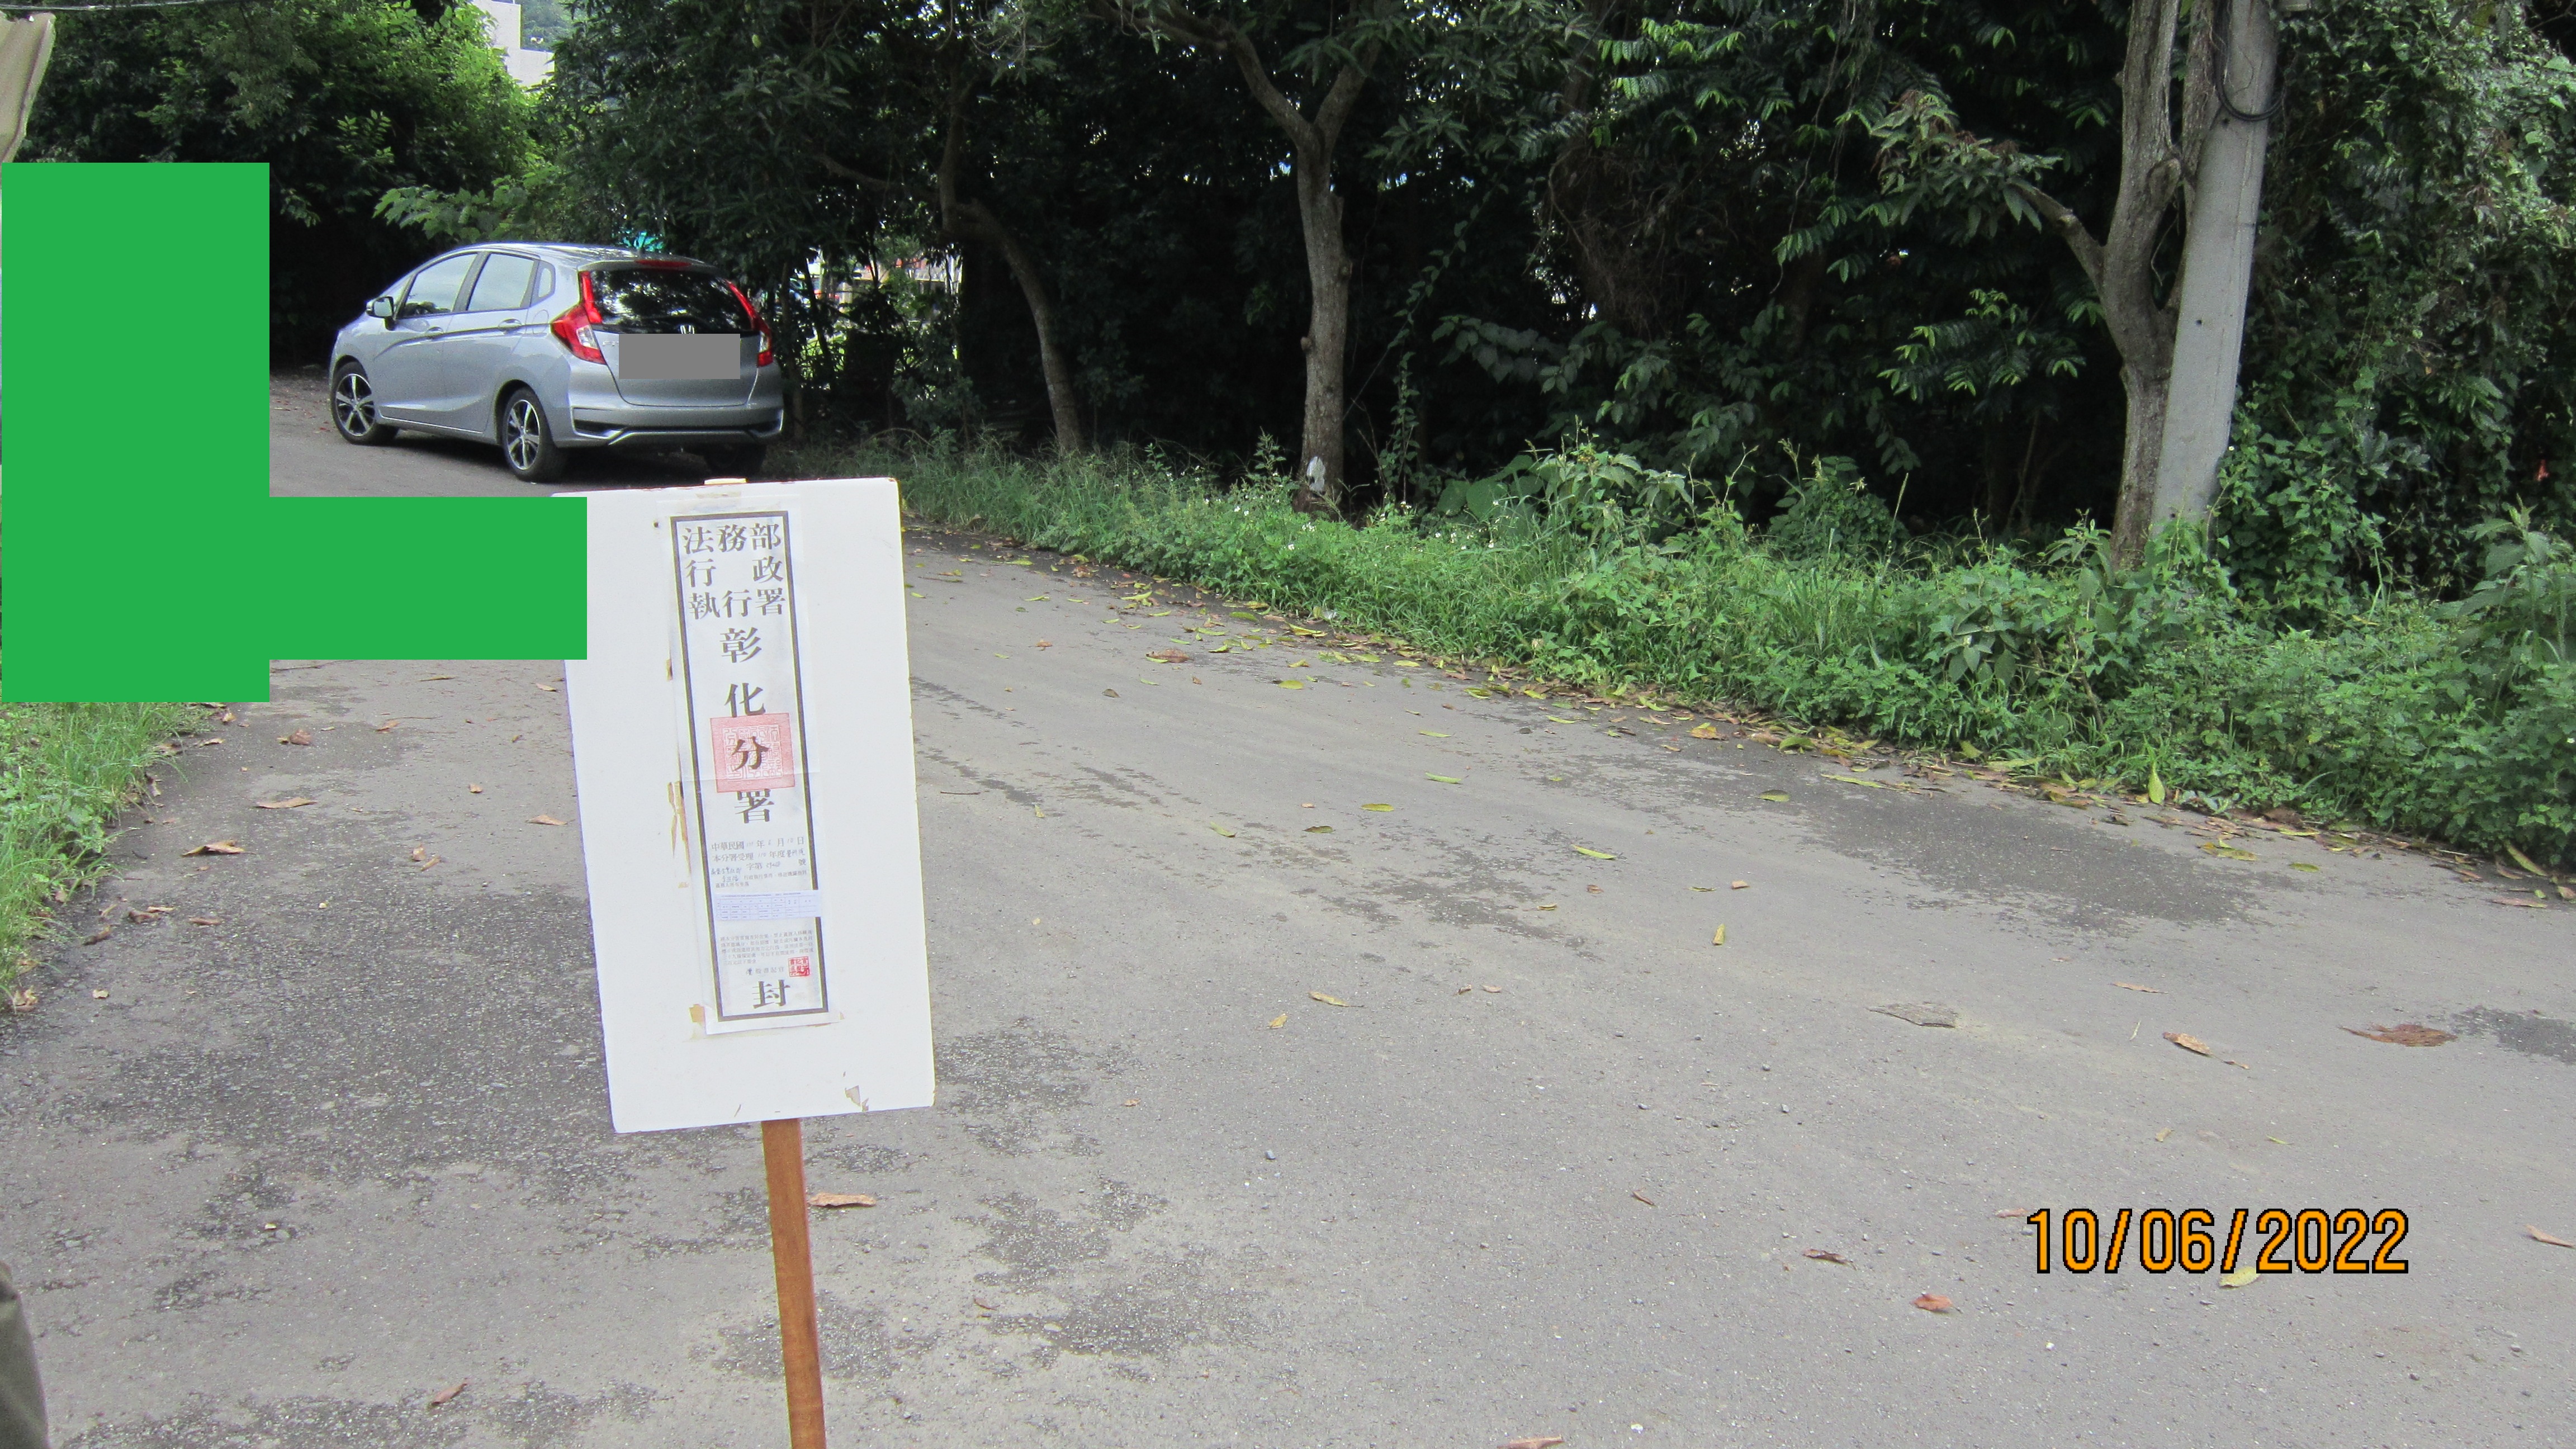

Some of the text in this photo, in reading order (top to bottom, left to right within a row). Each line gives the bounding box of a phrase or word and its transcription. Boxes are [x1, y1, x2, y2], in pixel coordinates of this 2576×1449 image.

[682, 523, 782, 554] 法務部
[689, 587, 786, 619] 執行署
[719, 627, 775, 823] 彰化分署
[752, 979, 791, 1009] 封
